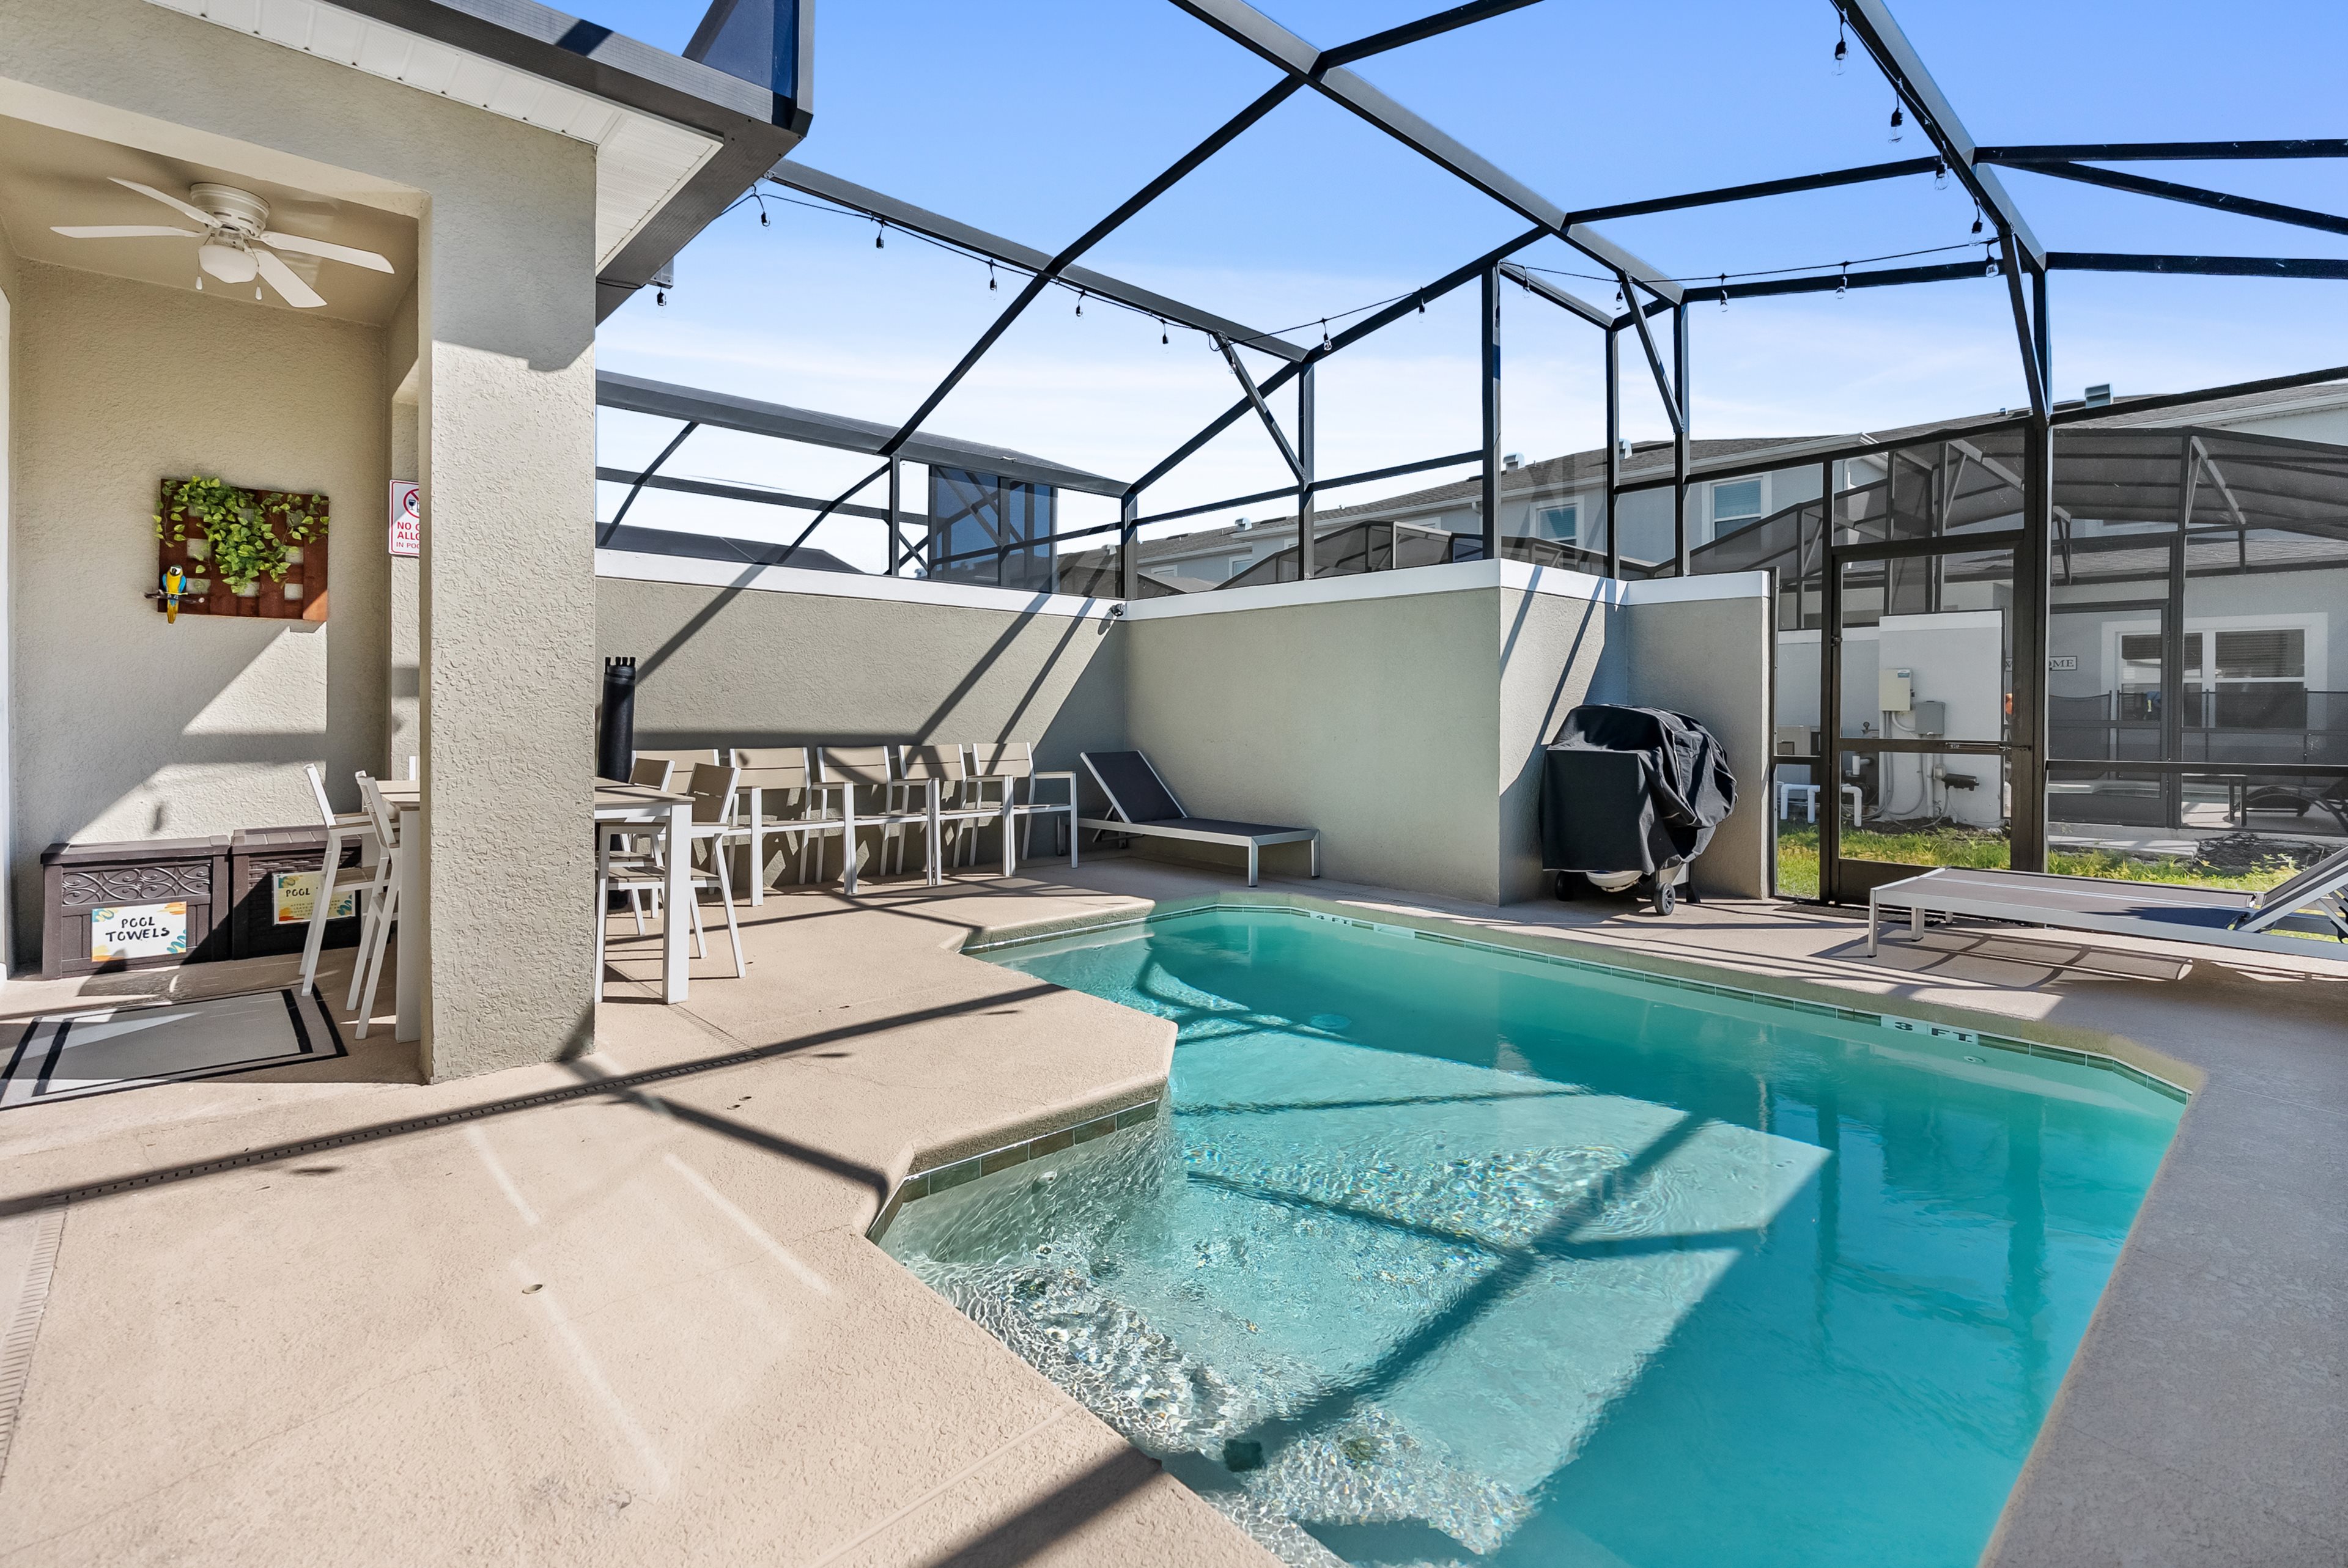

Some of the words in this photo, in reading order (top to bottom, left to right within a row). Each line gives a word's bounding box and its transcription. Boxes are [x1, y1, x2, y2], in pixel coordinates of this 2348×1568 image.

[397, 521, 412, 530] NO
[397, 531, 419, 540] ALLO
[286, 888, 311, 897] POOL
[121, 916, 155, 928] POOL
[105, 927, 170, 941] TOWELS
[1894, 1021, 1913, 1031] 3
